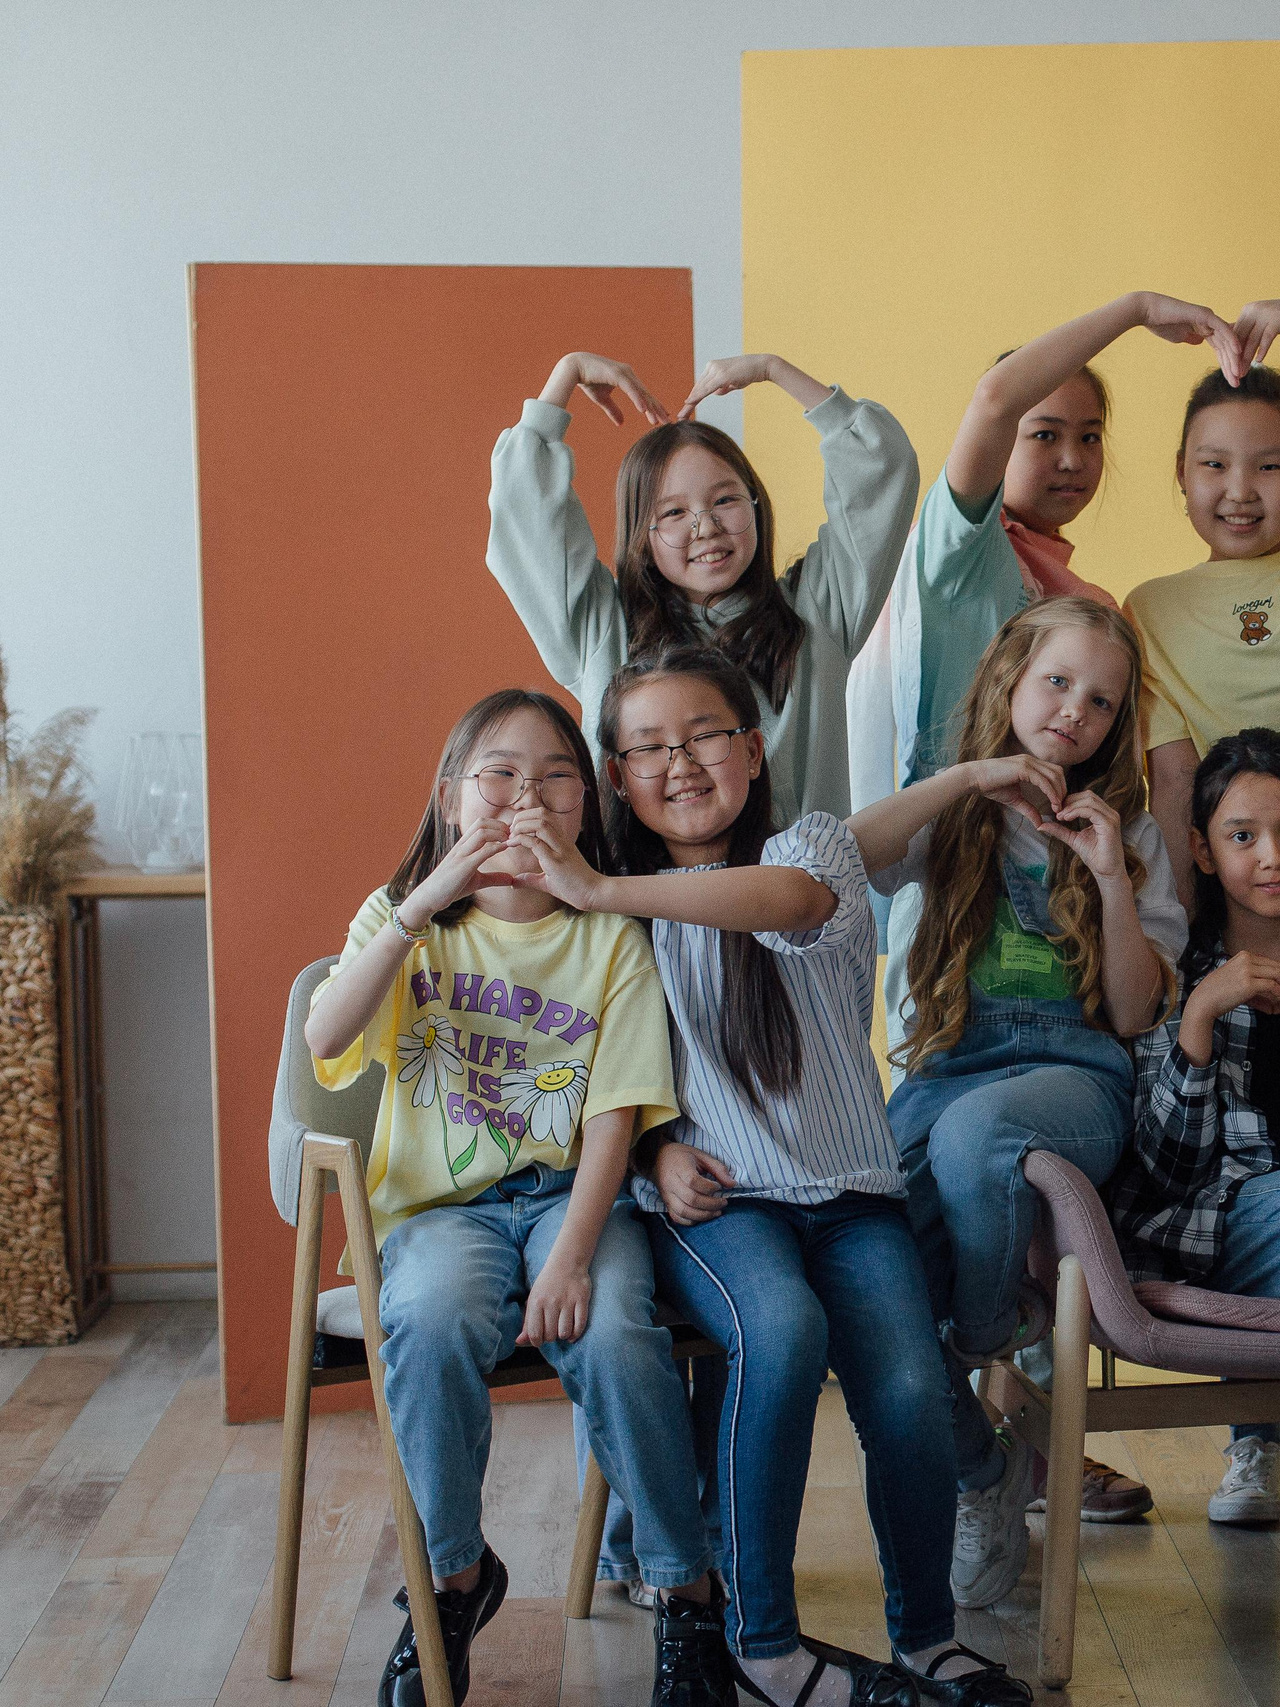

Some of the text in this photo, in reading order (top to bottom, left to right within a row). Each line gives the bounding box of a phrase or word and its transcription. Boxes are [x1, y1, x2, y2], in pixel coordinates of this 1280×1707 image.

[449, 972, 599, 1045] HAPPY
[452, 1026, 528, 1070] LIFE
[468, 1067, 502, 1104] IS
[447, 1092, 526, 1139] GOOD
